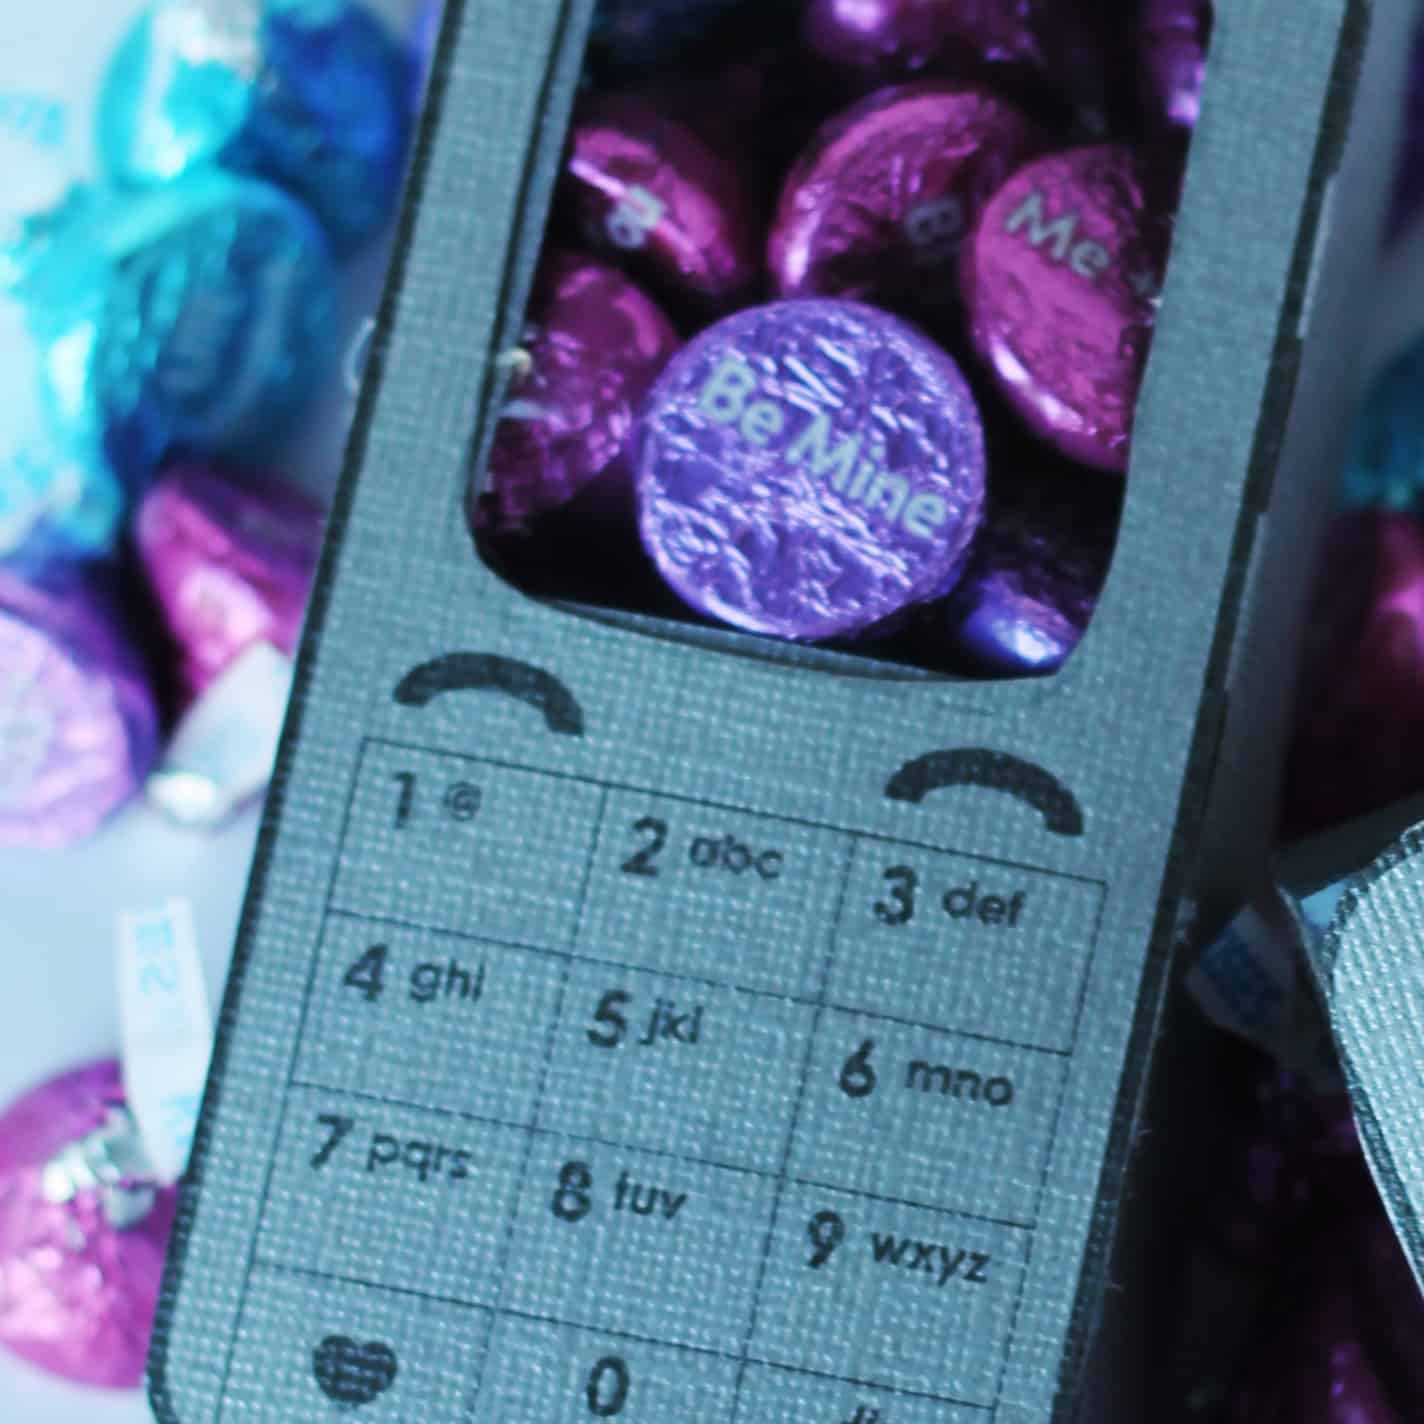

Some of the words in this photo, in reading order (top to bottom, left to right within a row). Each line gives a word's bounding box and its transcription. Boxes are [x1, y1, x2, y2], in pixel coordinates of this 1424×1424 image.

[1004, 190, 1110, 278] Me
[698, 357, 784, 448] Be
[785, 412, 948, 539] Mine
[393, 771, 416, 828] 1
[443, 781, 483, 822] @
[620, 815, 669, 877] 2
[689, 832, 784, 881] abc
[872, 864, 920, 926] 3
[941, 881, 1026, 928] def
[345, 942, 388, 1004] 4
[409, 959, 488, 1003] ghi
[586, 988, 633, 1048] 5
[637, 997, 704, 1048] jkl
[837, 1039, 877, 1099] 6
[904, 1059, 1015, 1107] mno
[310, 1114, 355, 1169] 7
[366, 1133, 473, 1182] pqrs
[551, 1161, 593, 1222] 8
[613, 1171, 689, 1220] tuv
[806, 1209, 847, 1269] 9
[869, 1231, 992, 1287] wxyz
[585, 1355, 630, 1418] 0
